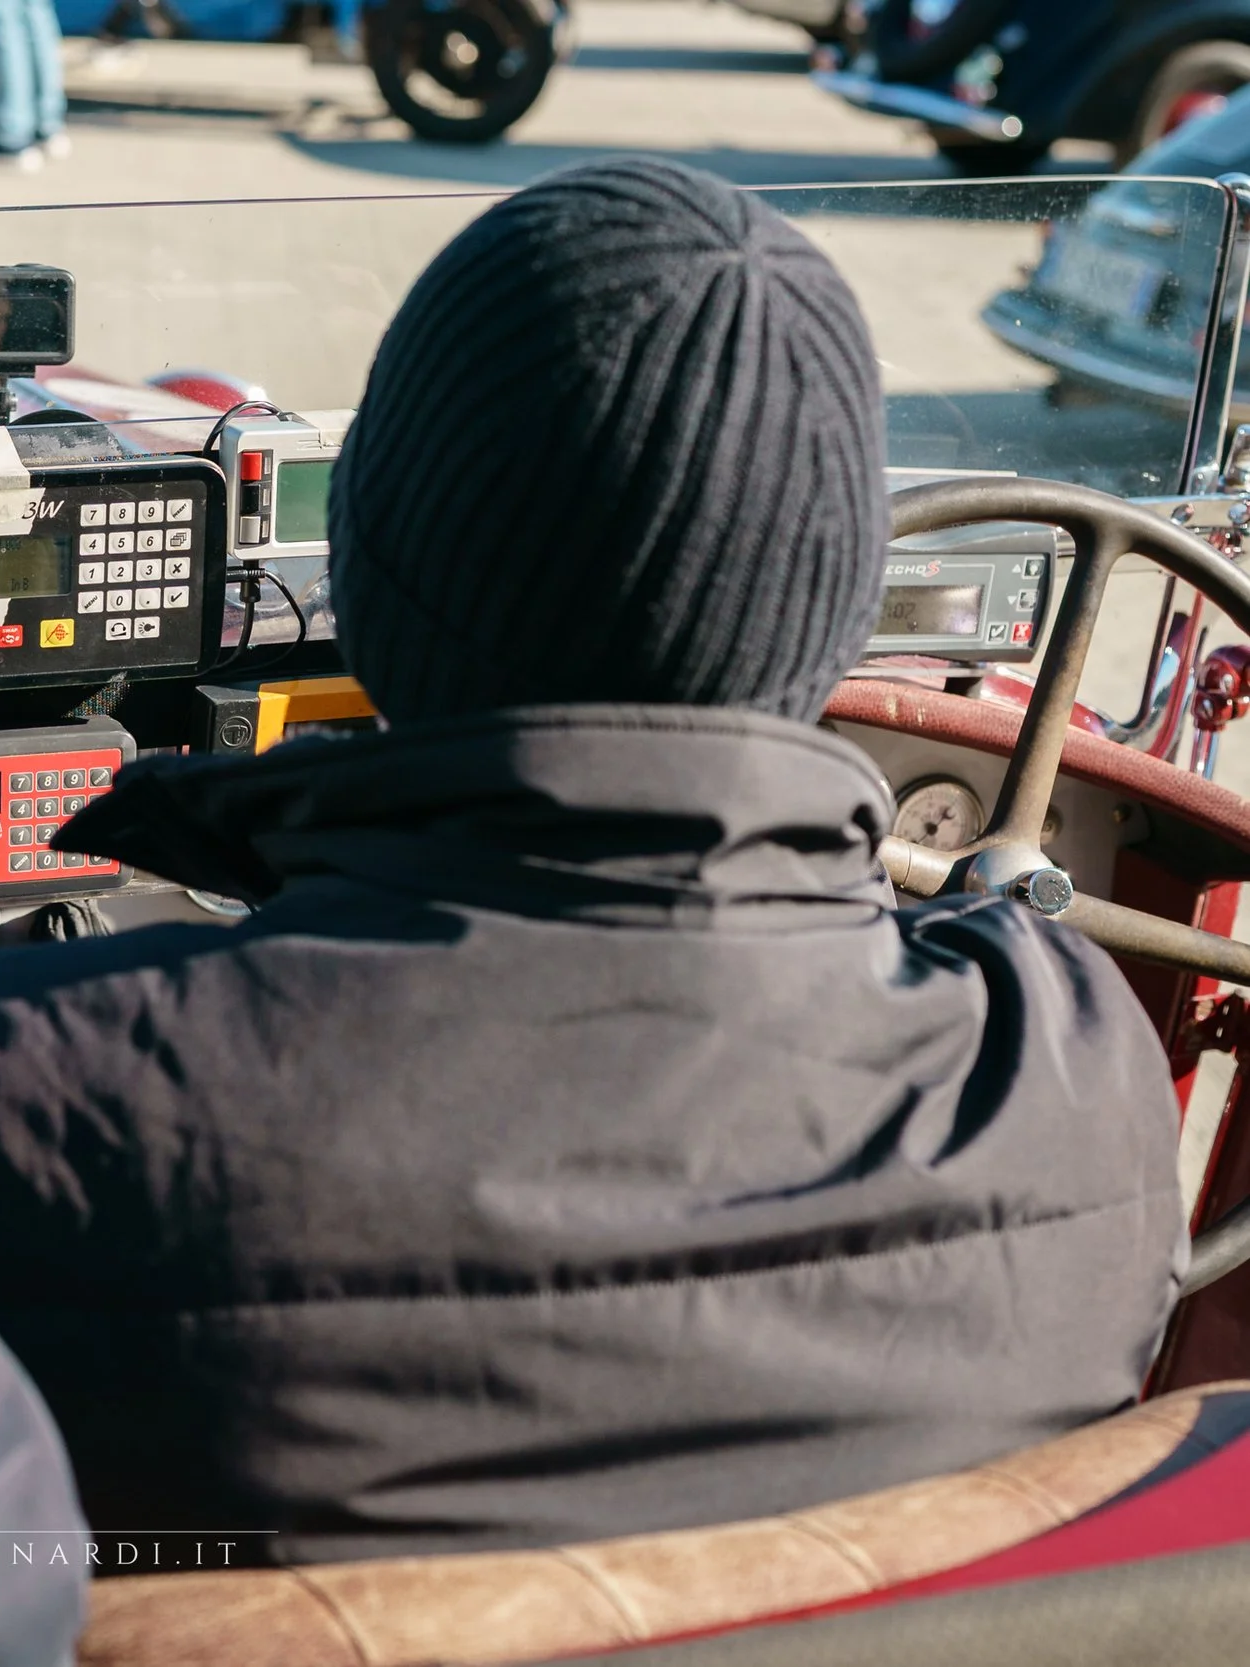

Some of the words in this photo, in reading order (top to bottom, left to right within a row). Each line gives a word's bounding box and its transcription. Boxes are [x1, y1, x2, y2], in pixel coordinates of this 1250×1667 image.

[22, 500, 65, 520] 3W
[89, 510, 98, 521] 7
[118, 508, 127, 519] 8
[147, 506, 155, 518] 9
[89, 539, 97, 550] 4
[118, 537, 126, 549] 5
[146, 536, 154, 547] 6
[88, 568, 95, 579] 1
[116, 566, 125, 578] 2
[145, 565, 153, 576] 3
[84, 595, 98, 610] MENU
[115, 595, 124, 606] 0
[17, 777, 25, 789] 7
[44, 775, 52, 787] 8
[70, 774, 79, 785] 9
[17, 803, 26, 815] 4
[44, 802, 52, 813] 5
[70, 800, 78, 811] 6
[17, 830, 25, 842] 1
[43, 828, 52, 840] 2
[43, 855, 52, 866] 0
